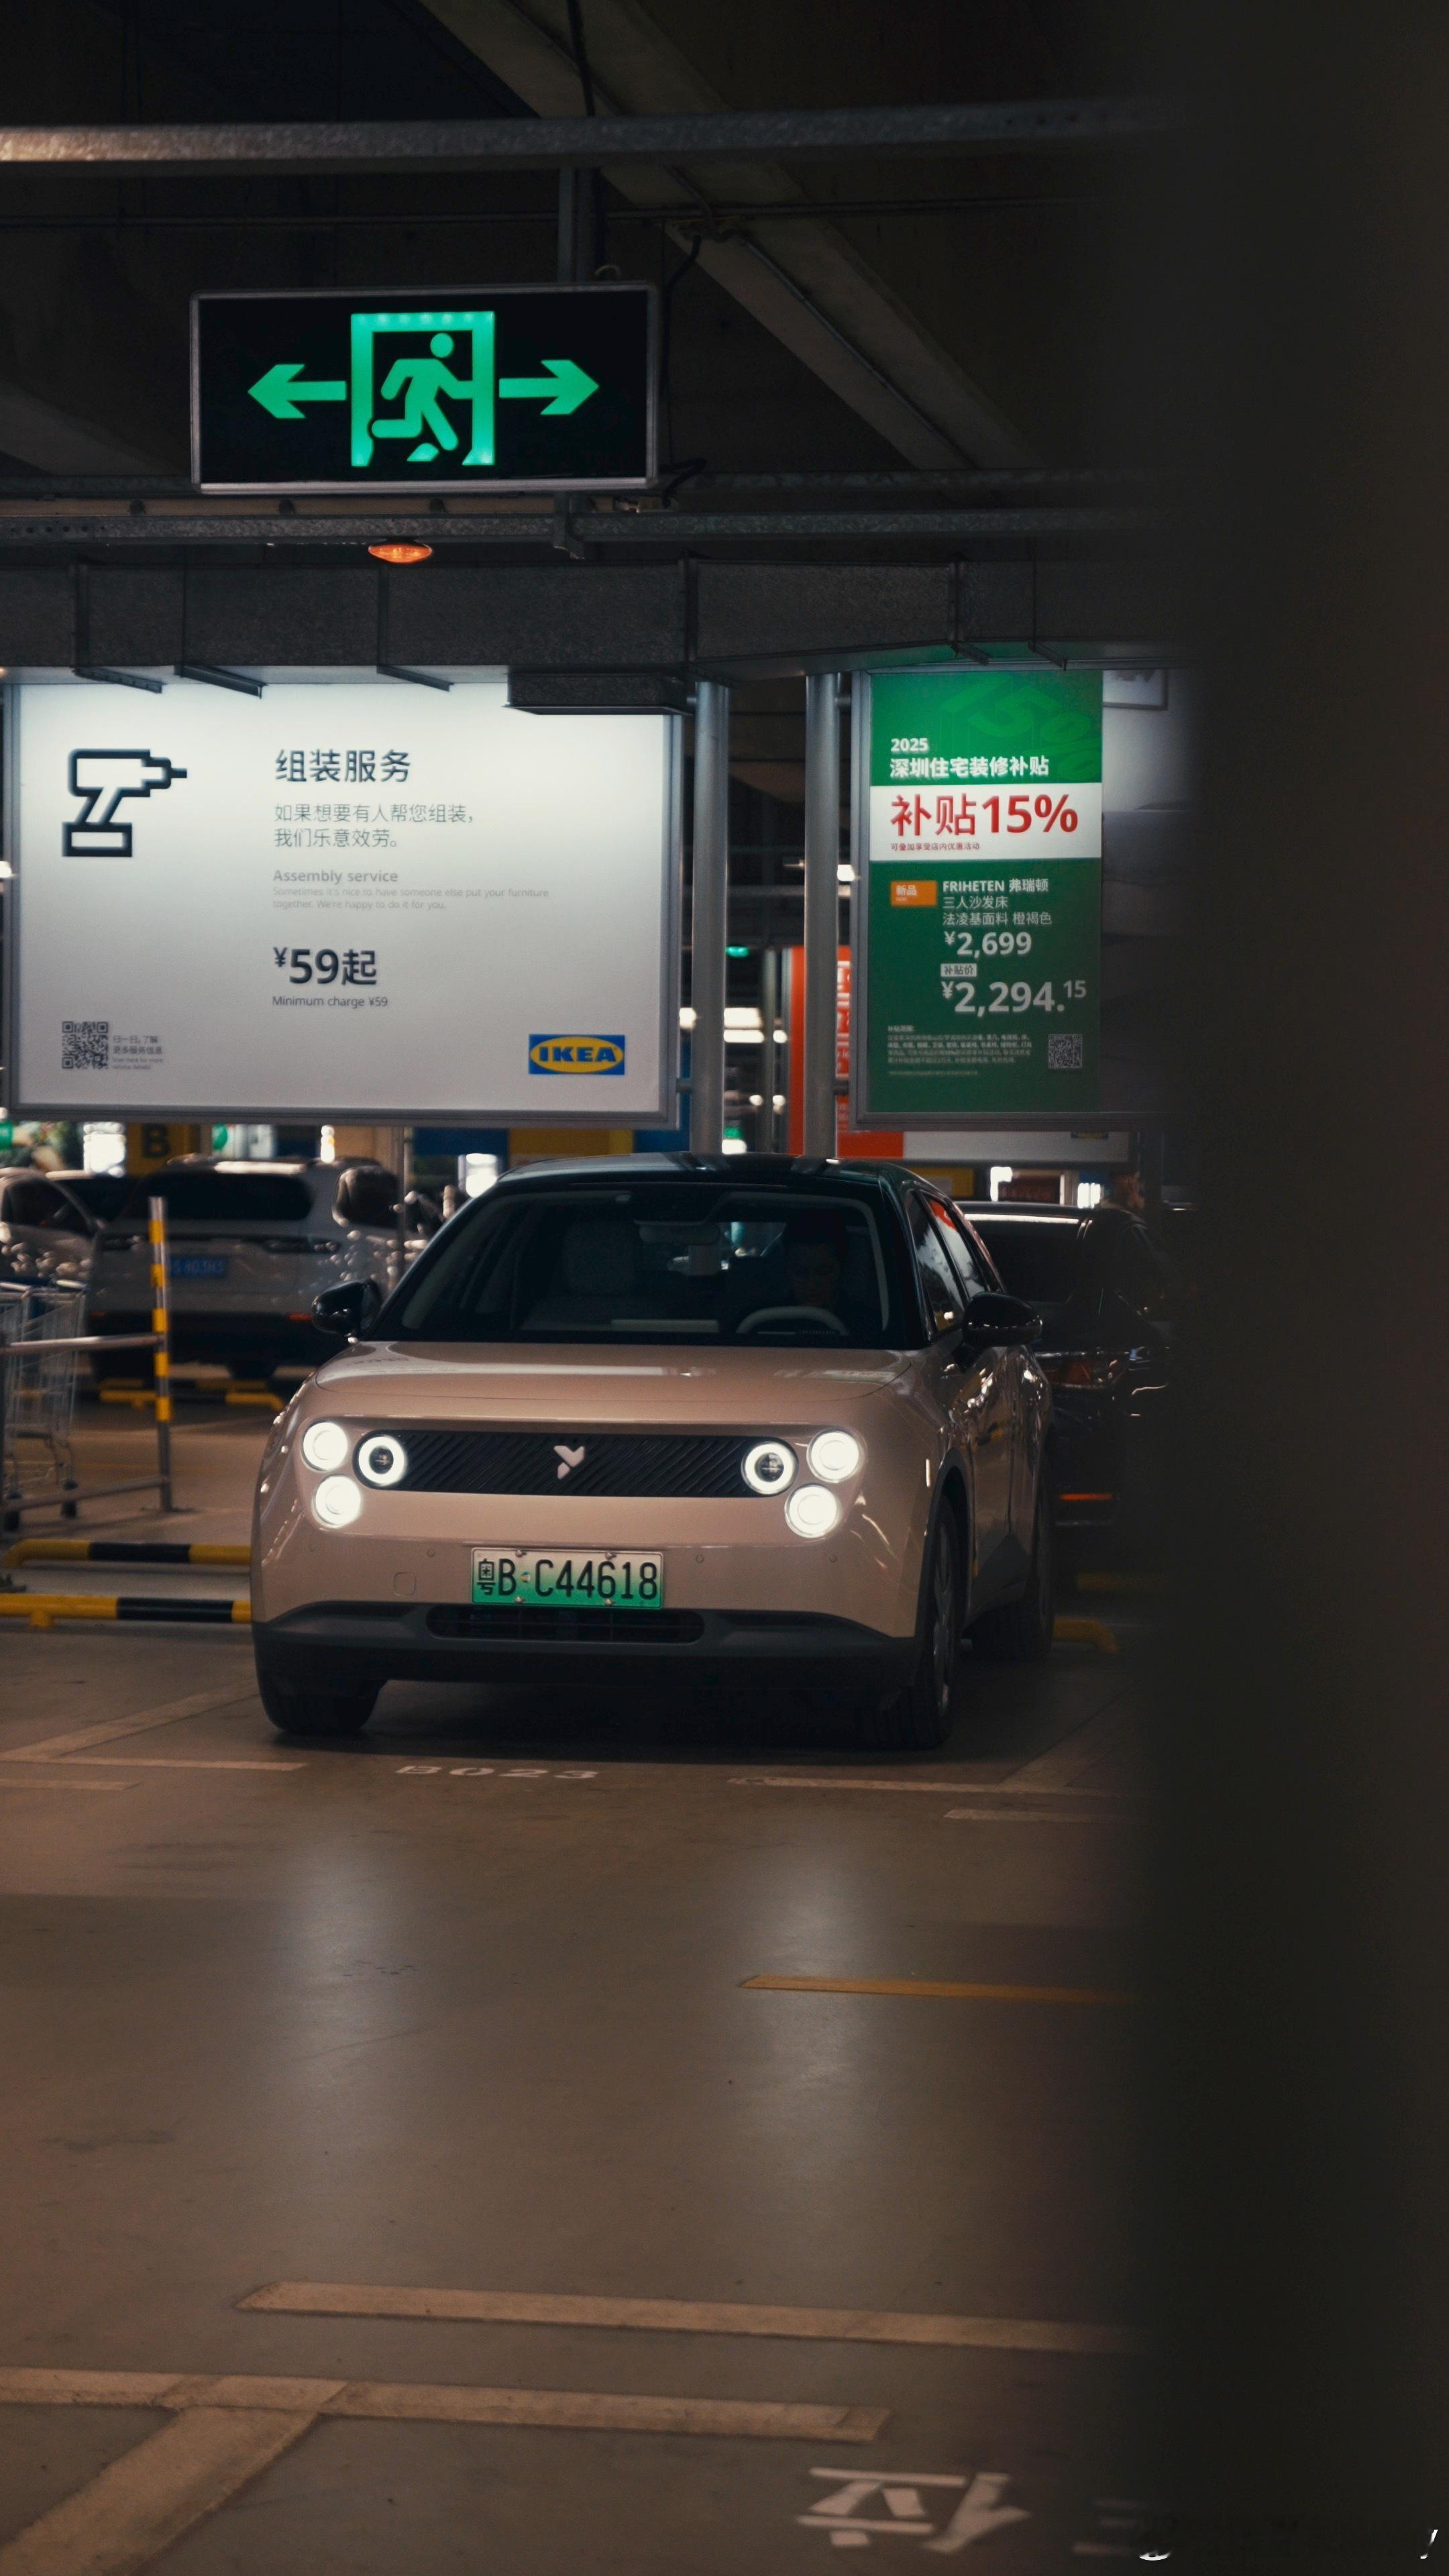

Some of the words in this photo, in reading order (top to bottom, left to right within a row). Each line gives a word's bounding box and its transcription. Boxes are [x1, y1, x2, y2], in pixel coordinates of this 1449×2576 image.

[890, 738, 930, 753] 2025
[275, 749, 411, 783] 组装服务
[890, 755, 1049, 778] 深圳住宅装修补贴
[274, 804, 474, 824] 如果想要有人帮您组装，
[890, 794, 1079, 837] 补贴15%
[274, 828, 398, 849] 我们乐意效劳。
[273, 870, 343, 885] Assembly
[347, 870, 398, 883] service
[273, 887, 323, 896] Sometimes
[342, 888, 360, 896] nice
[363, 888, 373, 896] to
[375, 888, 397, 896] have
[399, 889, 442, 897] someone
[445, 888, 464, 897] else
[466, 888, 482, 899] put
[484, 890, 504, 899] your
[508, 888, 549, 897] furniture
[943, 880, 1005, 892] FRIHETEN
[1008, 878, 1049, 893] 弗瑞顿
[345, 900, 373, 910] happy
[375, 901, 385, 909] to
[388, 900, 400, 909] do
[411, 900, 425, 909] for
[943, 897, 1008, 909] 三人沙发床
[943, 912, 1008, 926] 法凌基面料
[1012, 912, 1053, 926] 橙褐色
[944, 930, 1032, 959] ¥2,699
[273, 947, 378, 986] ¥59起
[943, 966, 974, 975] 补贴价
[272, 996, 325, 1006] Minimum
[327, 996, 365, 1010] charge
[368, 997, 388, 1007] ¥59
[539, 1046, 616, 1062] IKEA
